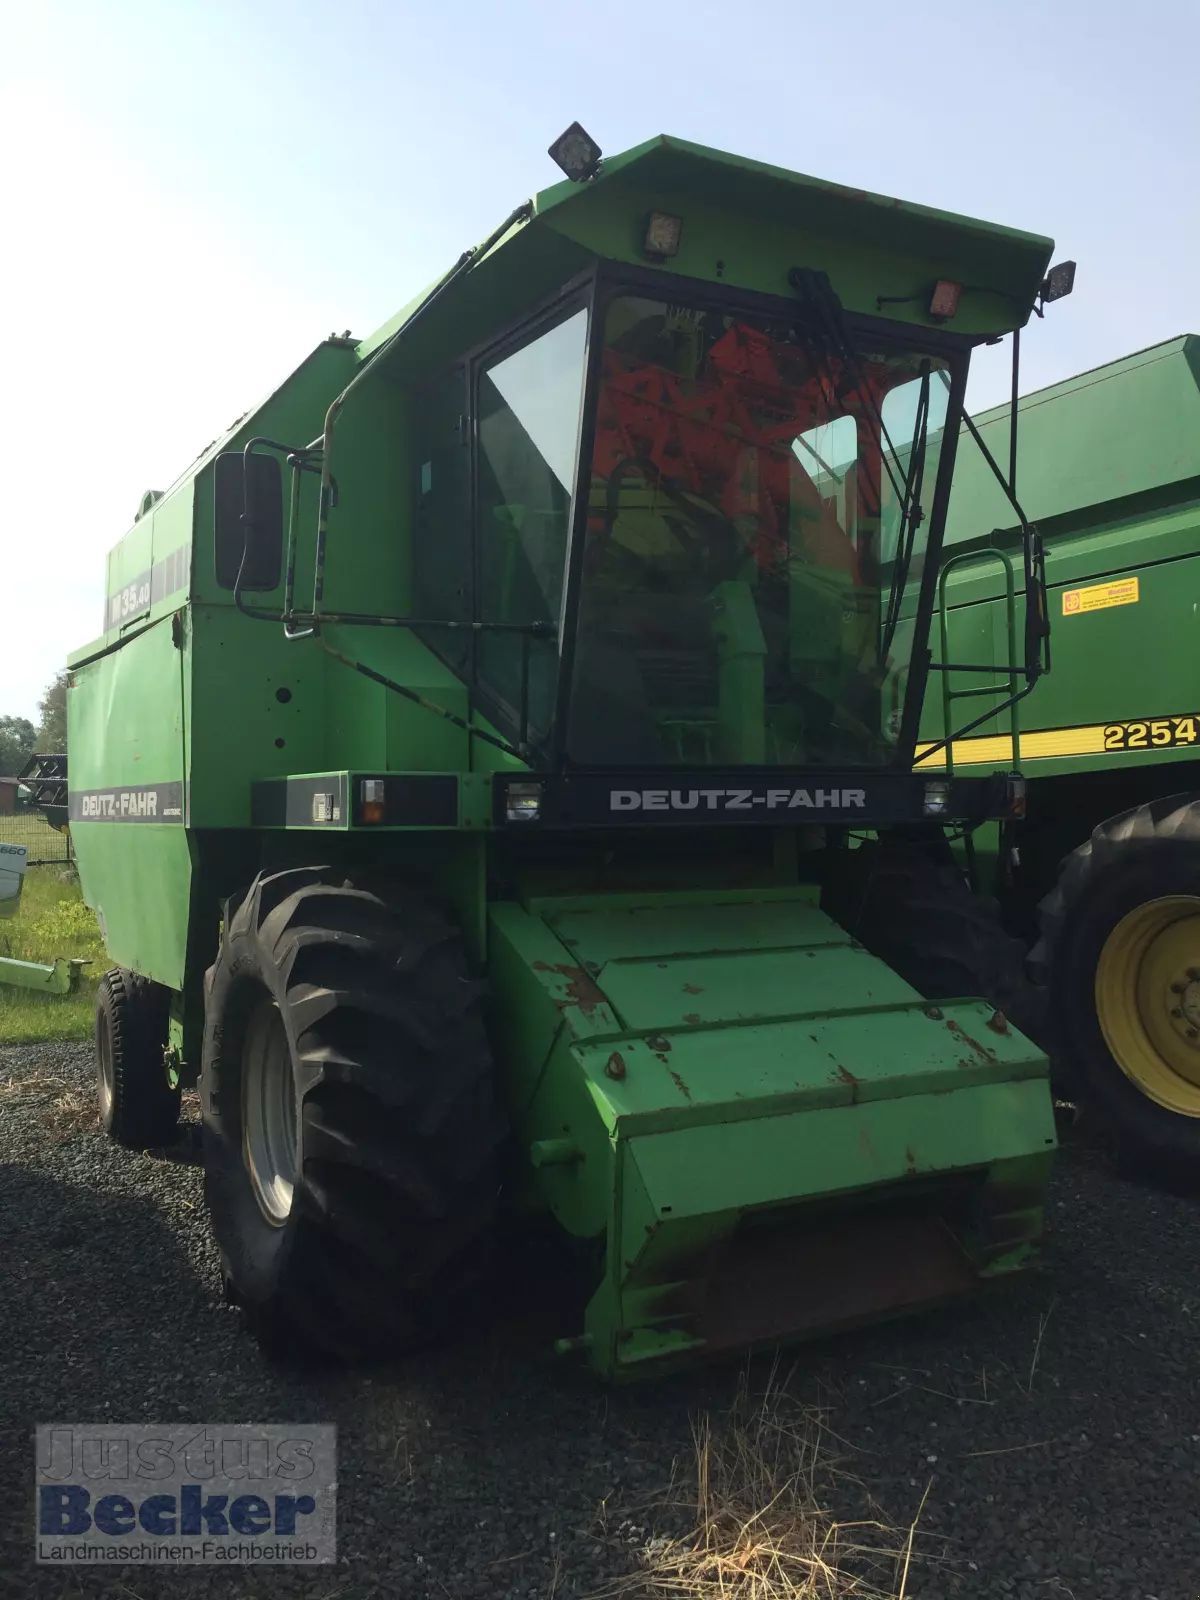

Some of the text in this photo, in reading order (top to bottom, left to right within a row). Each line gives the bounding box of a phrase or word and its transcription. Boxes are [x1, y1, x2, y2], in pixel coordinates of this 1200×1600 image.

[1105, 718, 1197, 749] 2254
[82, 791, 158, 816] DEUTZ-FAHR
[610, 789, 866, 811] DEUTZ-FAHR
